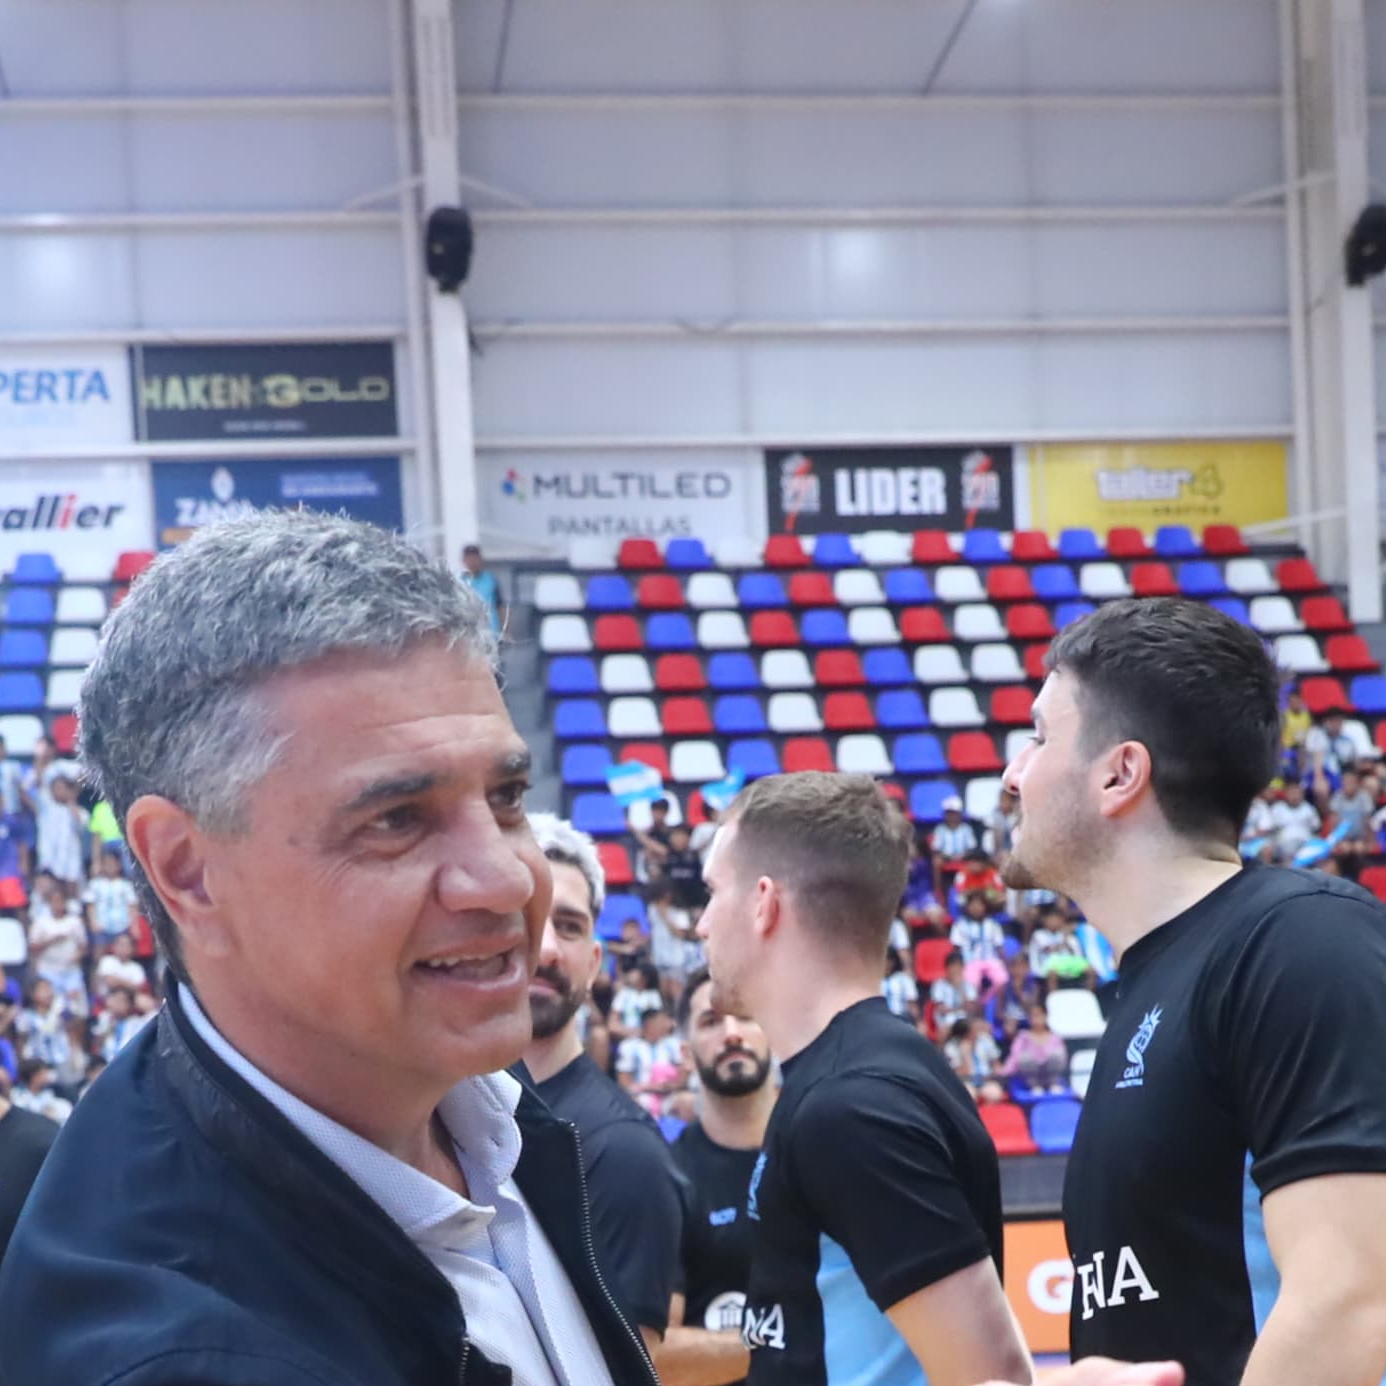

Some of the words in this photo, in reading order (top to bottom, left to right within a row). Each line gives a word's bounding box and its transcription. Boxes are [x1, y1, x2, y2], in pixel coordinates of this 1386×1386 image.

[533, 473, 731, 499] MULTILED
[835, 467, 946, 516] LIDER
[549, 517, 692, 535] PANTALLAS
